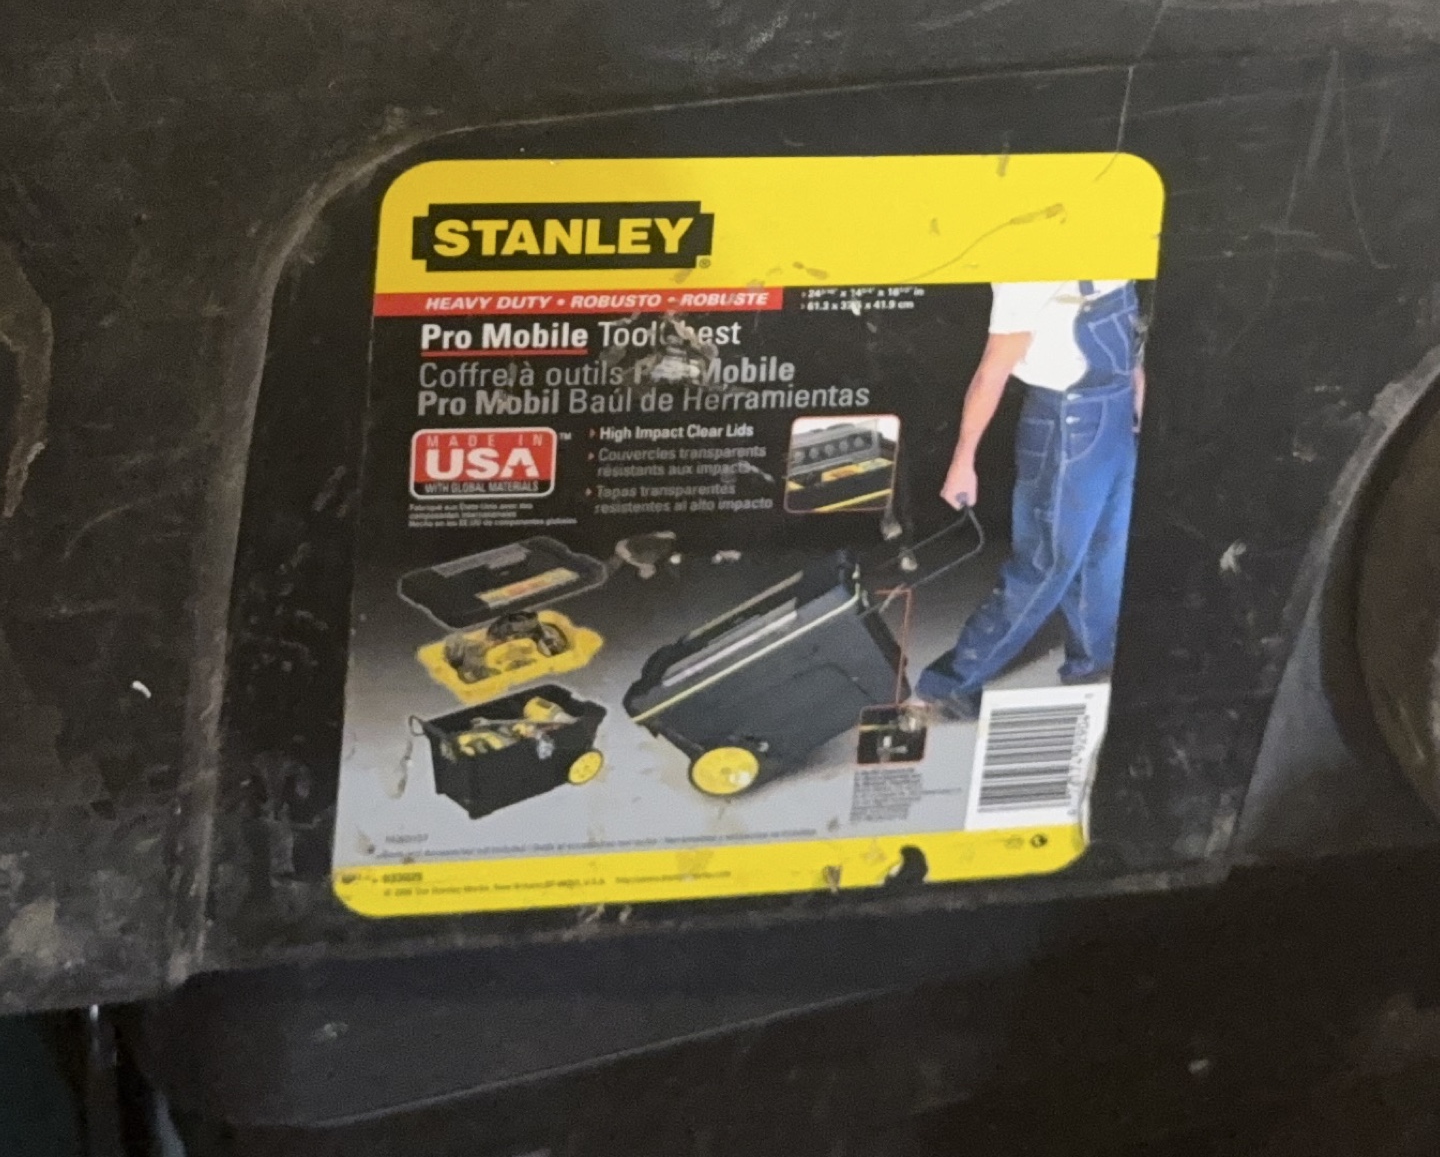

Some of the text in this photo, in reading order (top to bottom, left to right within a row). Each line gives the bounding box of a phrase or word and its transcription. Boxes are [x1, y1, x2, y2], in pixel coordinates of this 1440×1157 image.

[433, 217, 694, 257] STANLEY
[425, 291, 768, 311] HEAVY DUTY ROBUSTO ROBUSTE
[421, 323, 472, 350] Pro
[481, 321, 589, 348] Mobile
[419, 362, 513, 389] Coffre
[520, 361, 535, 387] à
[545, 359, 623, 387] outils
[702, 355, 795, 386] Mobile
[417, 383, 870, 416] Pro Mobil Baúl de Herramientas
[427, 434, 544, 447] MADE IN
[600, 422, 754, 443] High Impact Clear Lids
[425, 447, 539, 480] USA
[598, 445, 767, 462] Couvercles transparents
[668, 464, 693, 476] aux
[425, 481, 539, 493] WITH GLOBAL MATERIALS
[597, 483, 736, 499] Tapas transparentes
[690, 498, 715, 511] alto
[718, 497, 774, 513] impacto
